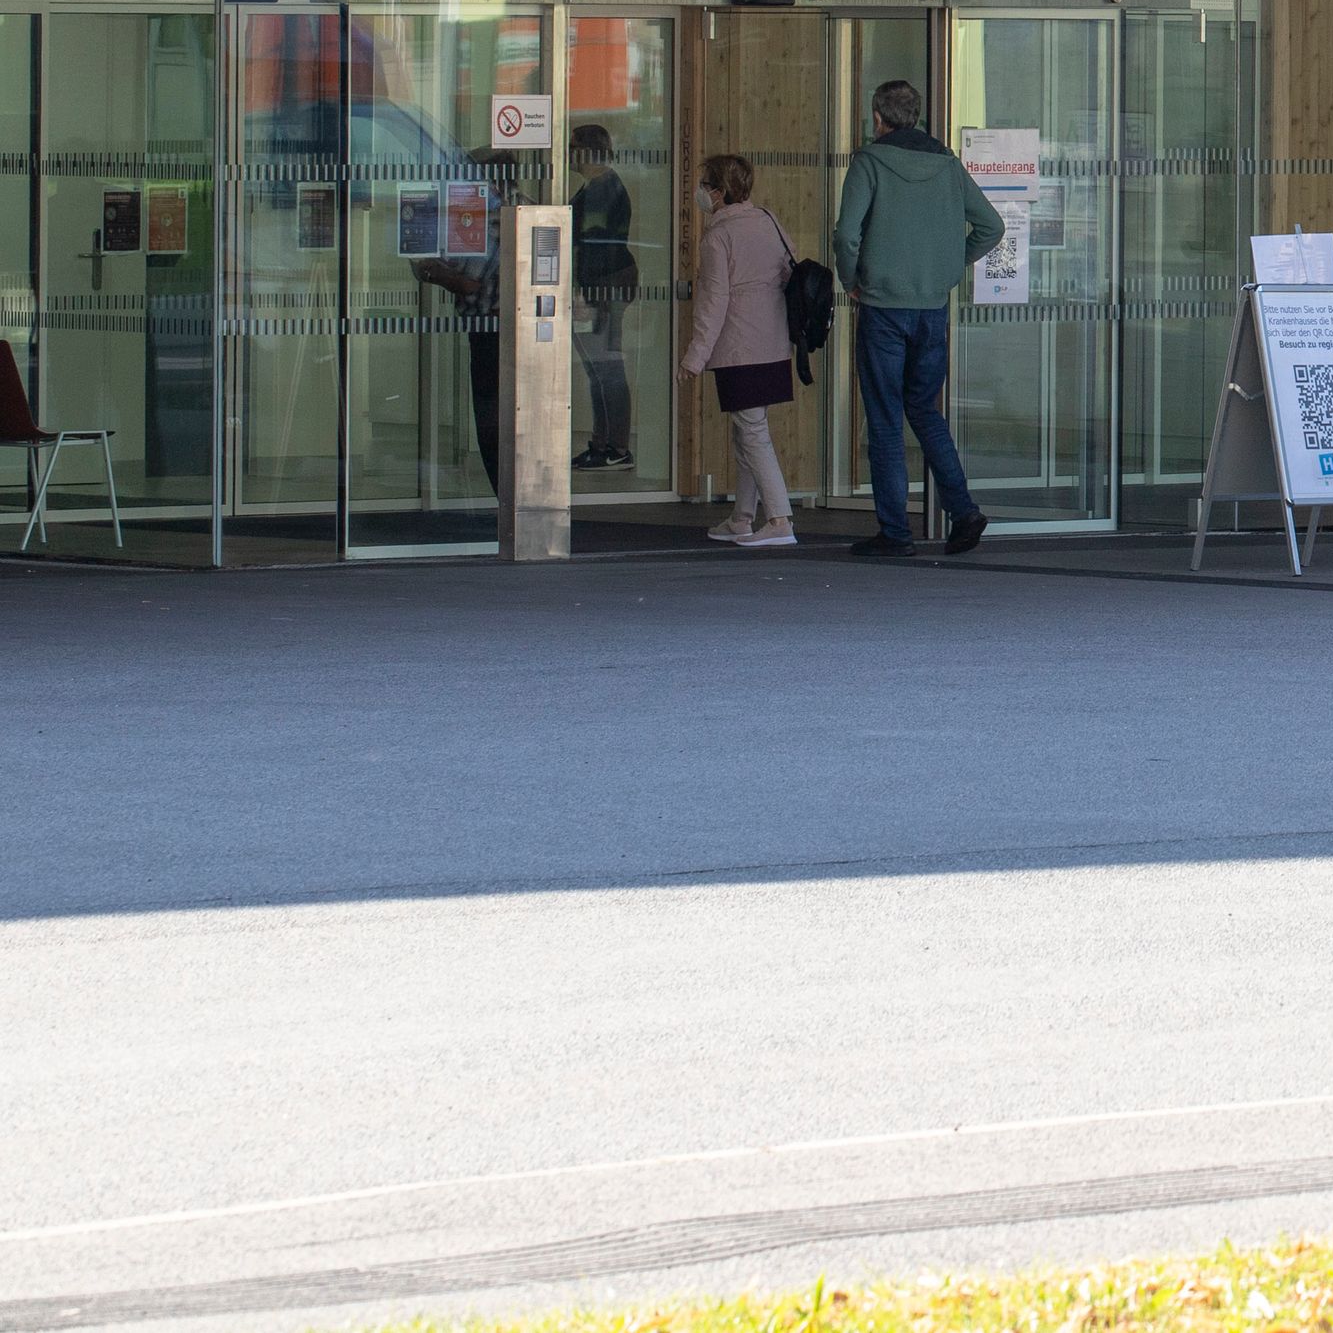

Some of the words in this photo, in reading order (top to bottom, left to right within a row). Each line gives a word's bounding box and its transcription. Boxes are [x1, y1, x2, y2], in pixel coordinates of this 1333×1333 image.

[966, 161, 1036, 174] Haupteingang
[1263, 305, 1279, 314] Bitte
[1280, 306, 1302, 314] nutzen
[1304, 305, 1315, 314] Sie
[1268, 317, 1318, 325] Krankenhauses
[1319, 317, 1330, 325] die
[1267, 329, 1280, 337] sich
[1282, 329, 1297, 337] über
[1299, 329, 1311, 337] den
[1312, 329, 1322, 338] QR
[1279, 340, 1306, 348] Besuch
